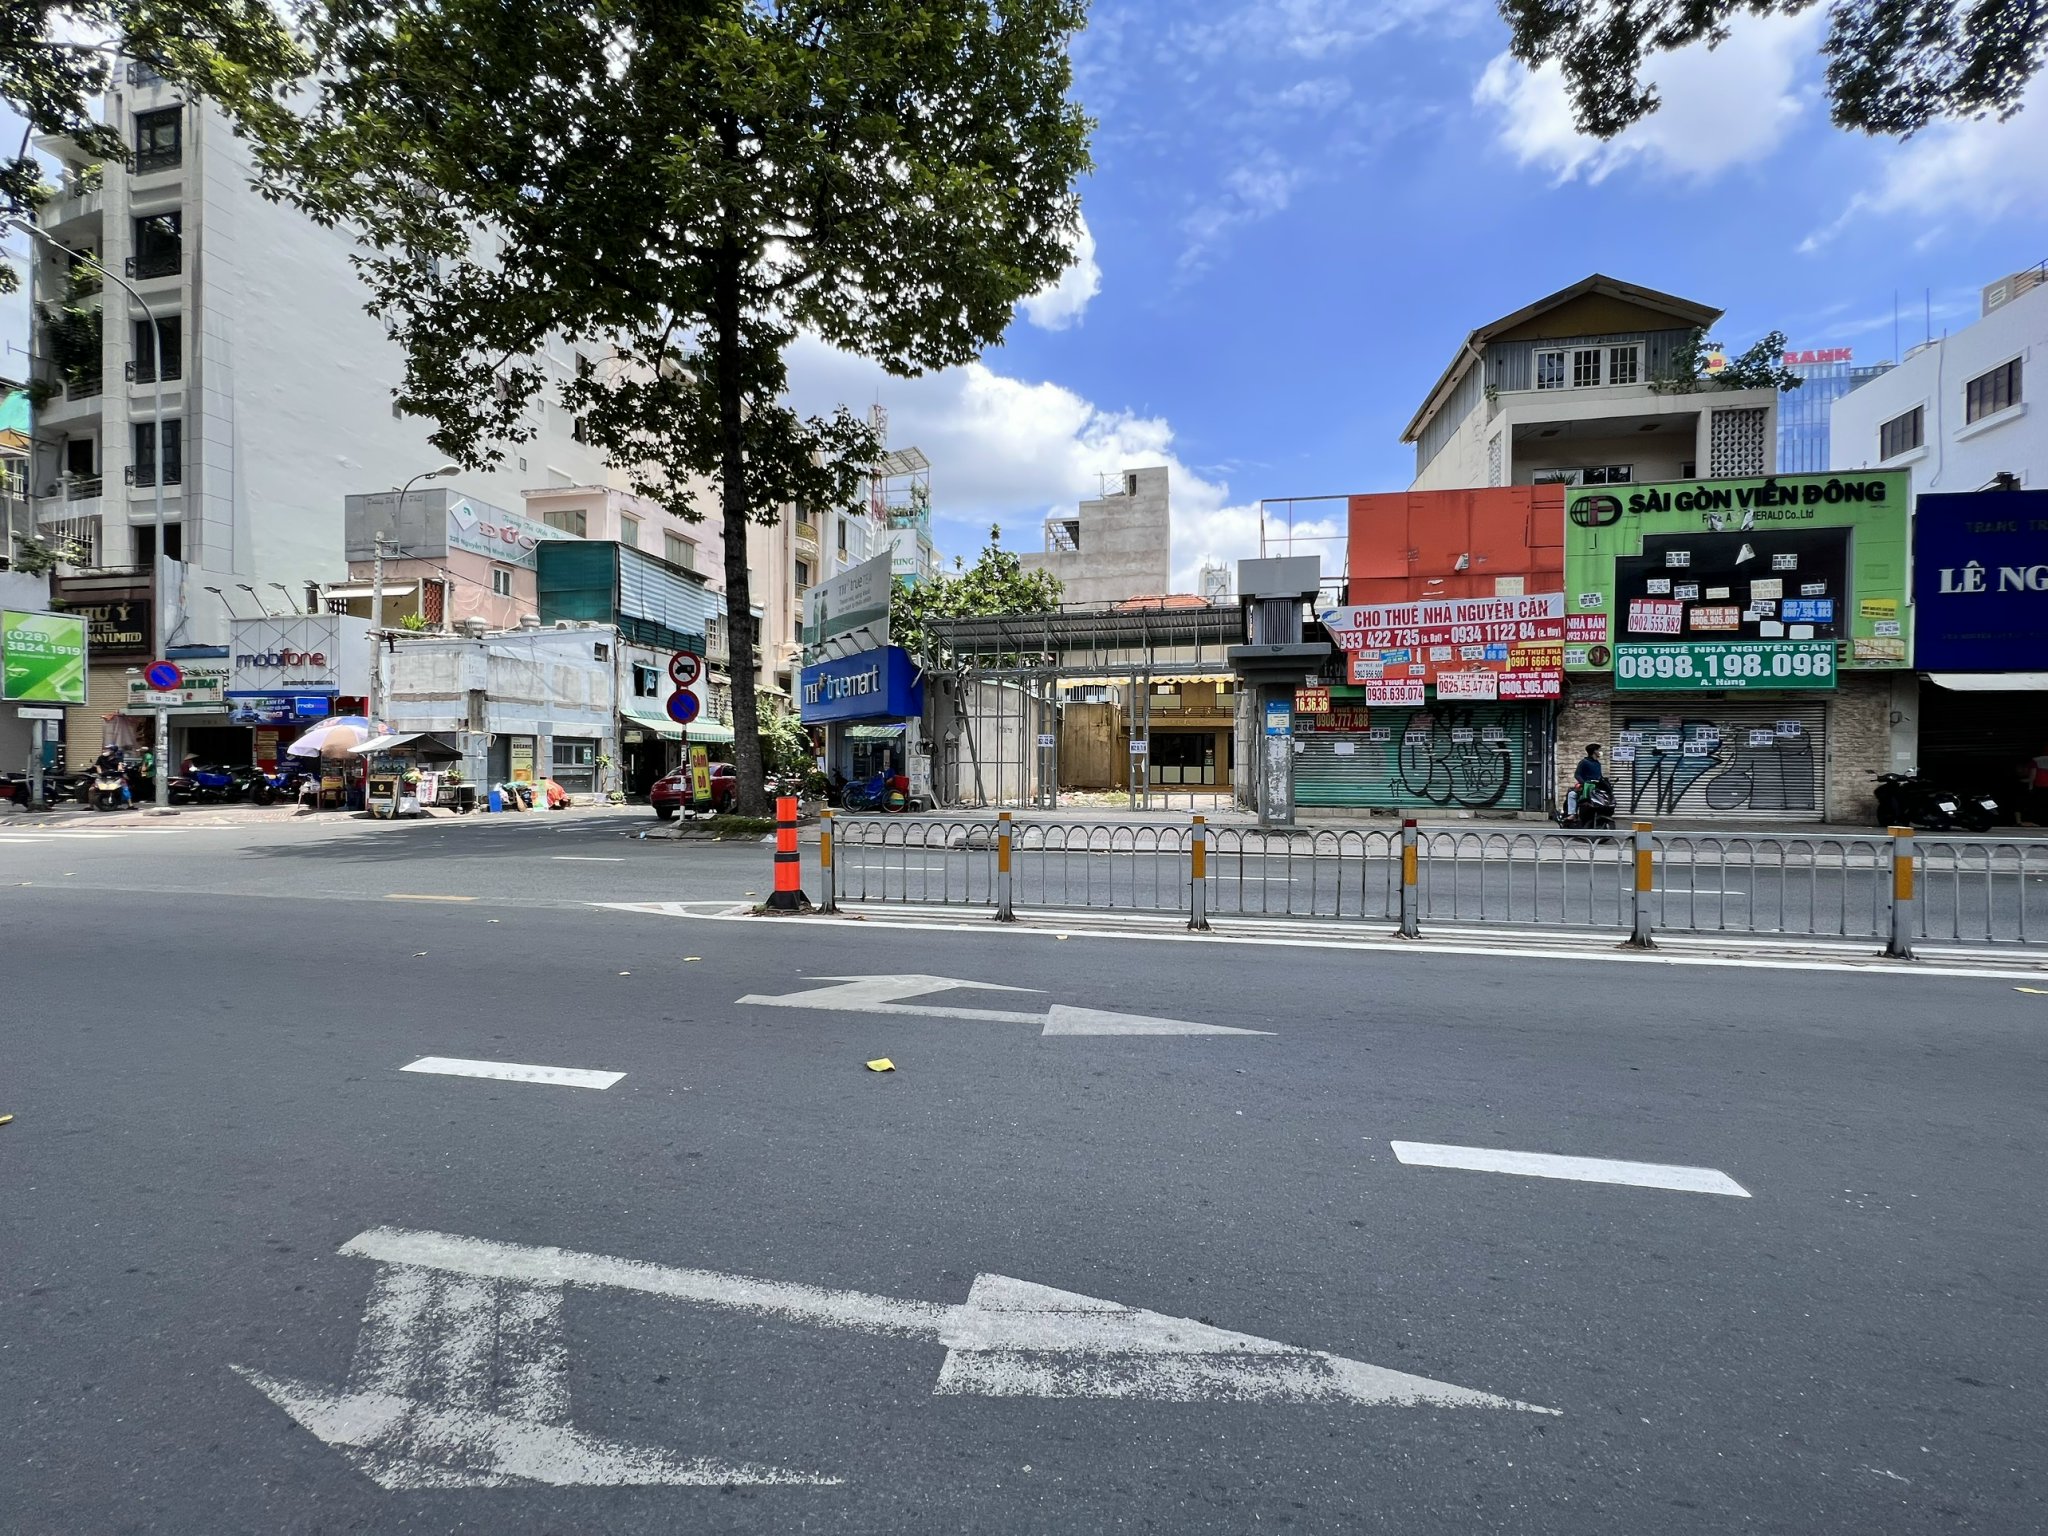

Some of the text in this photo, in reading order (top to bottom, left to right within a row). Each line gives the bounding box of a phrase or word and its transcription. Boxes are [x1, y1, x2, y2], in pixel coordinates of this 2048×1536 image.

[1629, 479, 1886, 513] SÀI GÒN VIỄN ĐÔNG
[1938, 560, 1987, 593] LÊ
[1354, 597, 1549, 628] CHO THUÊ NHÀ NGUYÊN CĂN
[88, 622, 118, 632] OTEL
[1567, 615, 1605, 629] NHÀ BÁN
[1629, 615, 1680, 632] 0902.555.882
[7, 631, 49, 643] (028)
[1367, 630, 1391, 647] 422
[1394, 629, 1419, 647] 735
[1451, 625, 1481, 643] 0934
[1486, 624, 1516, 641] 1122
[1520, 622, 1535, 640] 84
[7, 641, 80, 656] 3824.1919
[1652, 646, 1689, 654] THUÊ
[1694, 645, 1727, 653] NHÀ
[1730, 644, 1795, 653] NGUYÊN
[236, 648, 326, 668] mobifone
[1511, 656, 1529, 667] 0901
[1531, 656, 1550, 666] 6666
[1552, 655, 1561, 666] 06
[1618, 653, 1831, 678] 0898.198.098
[804, 665, 880, 704] TH truemart
[1715, 678, 1746, 687] Hùng
[1367, 687, 1423, 701] 0936.639.074
